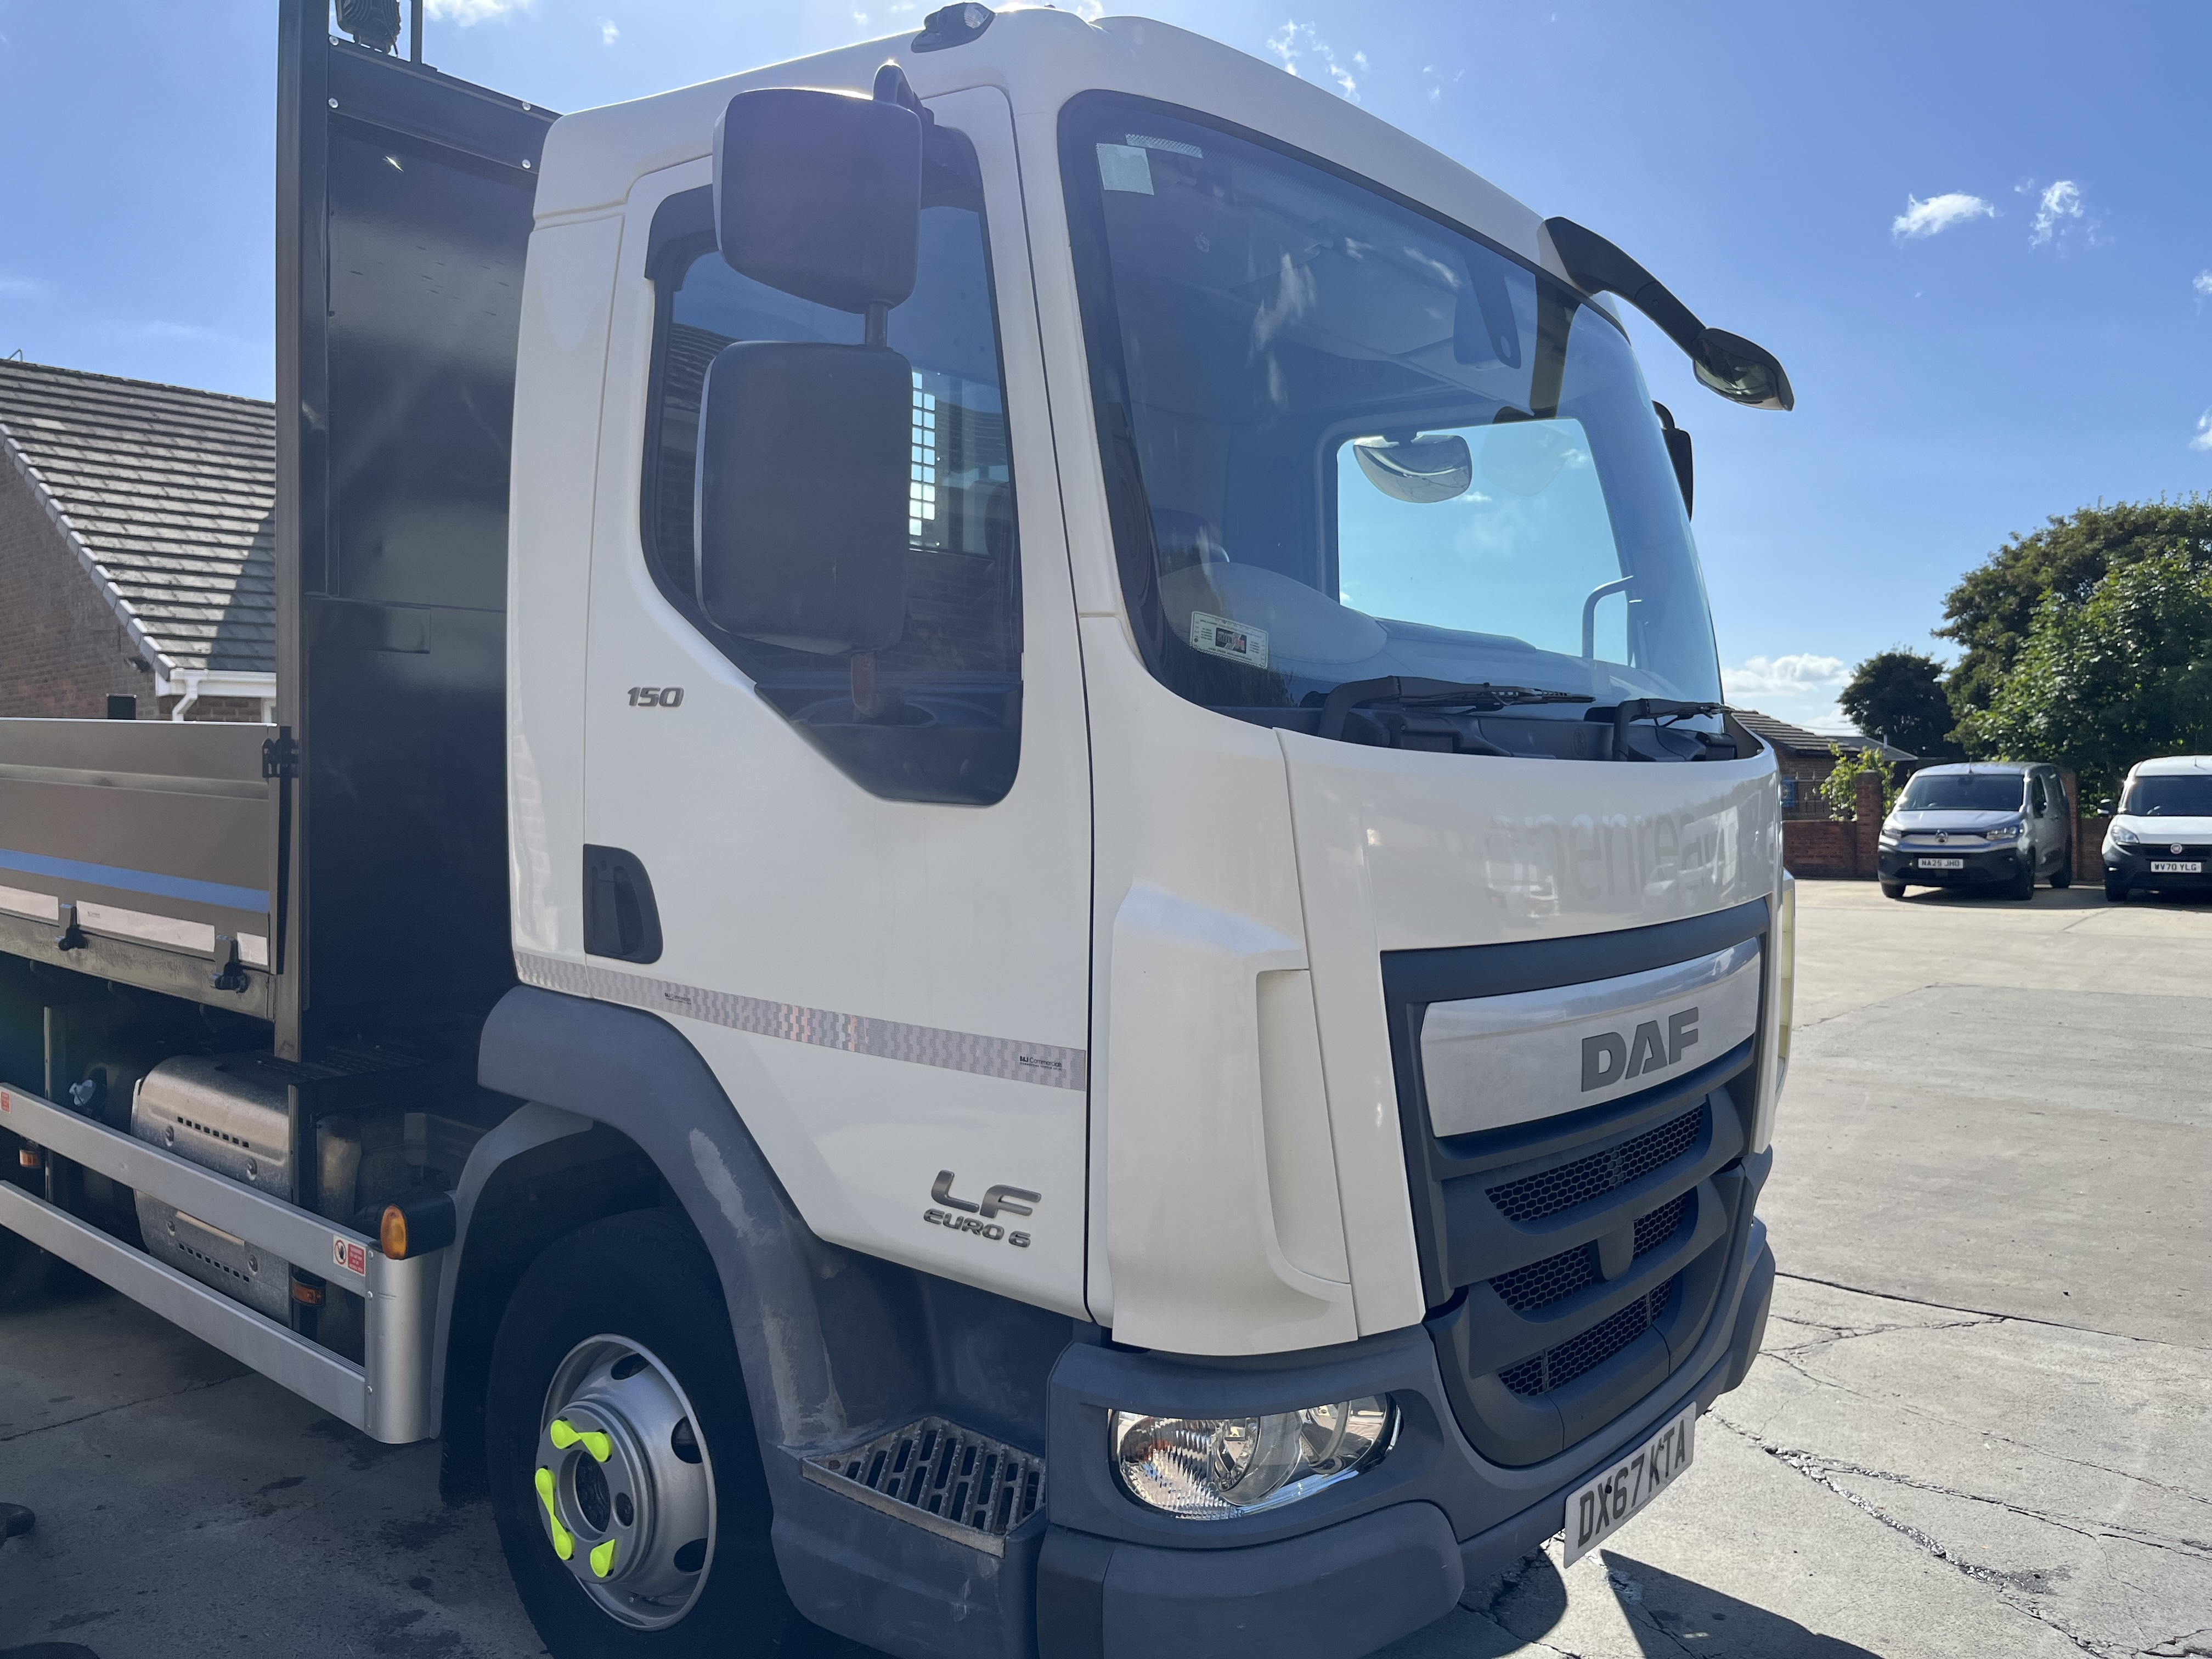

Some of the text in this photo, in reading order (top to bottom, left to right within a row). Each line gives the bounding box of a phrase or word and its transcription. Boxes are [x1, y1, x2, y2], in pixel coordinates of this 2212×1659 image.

[628, 687, 684, 707] 150
[1581, 1007, 1699, 1092] DAF
[931, 1169, 1042, 1218] LF
[923, 1208, 1031, 1248] EURO 6
[1578, 1419, 1685, 1549] DX67 KTA
